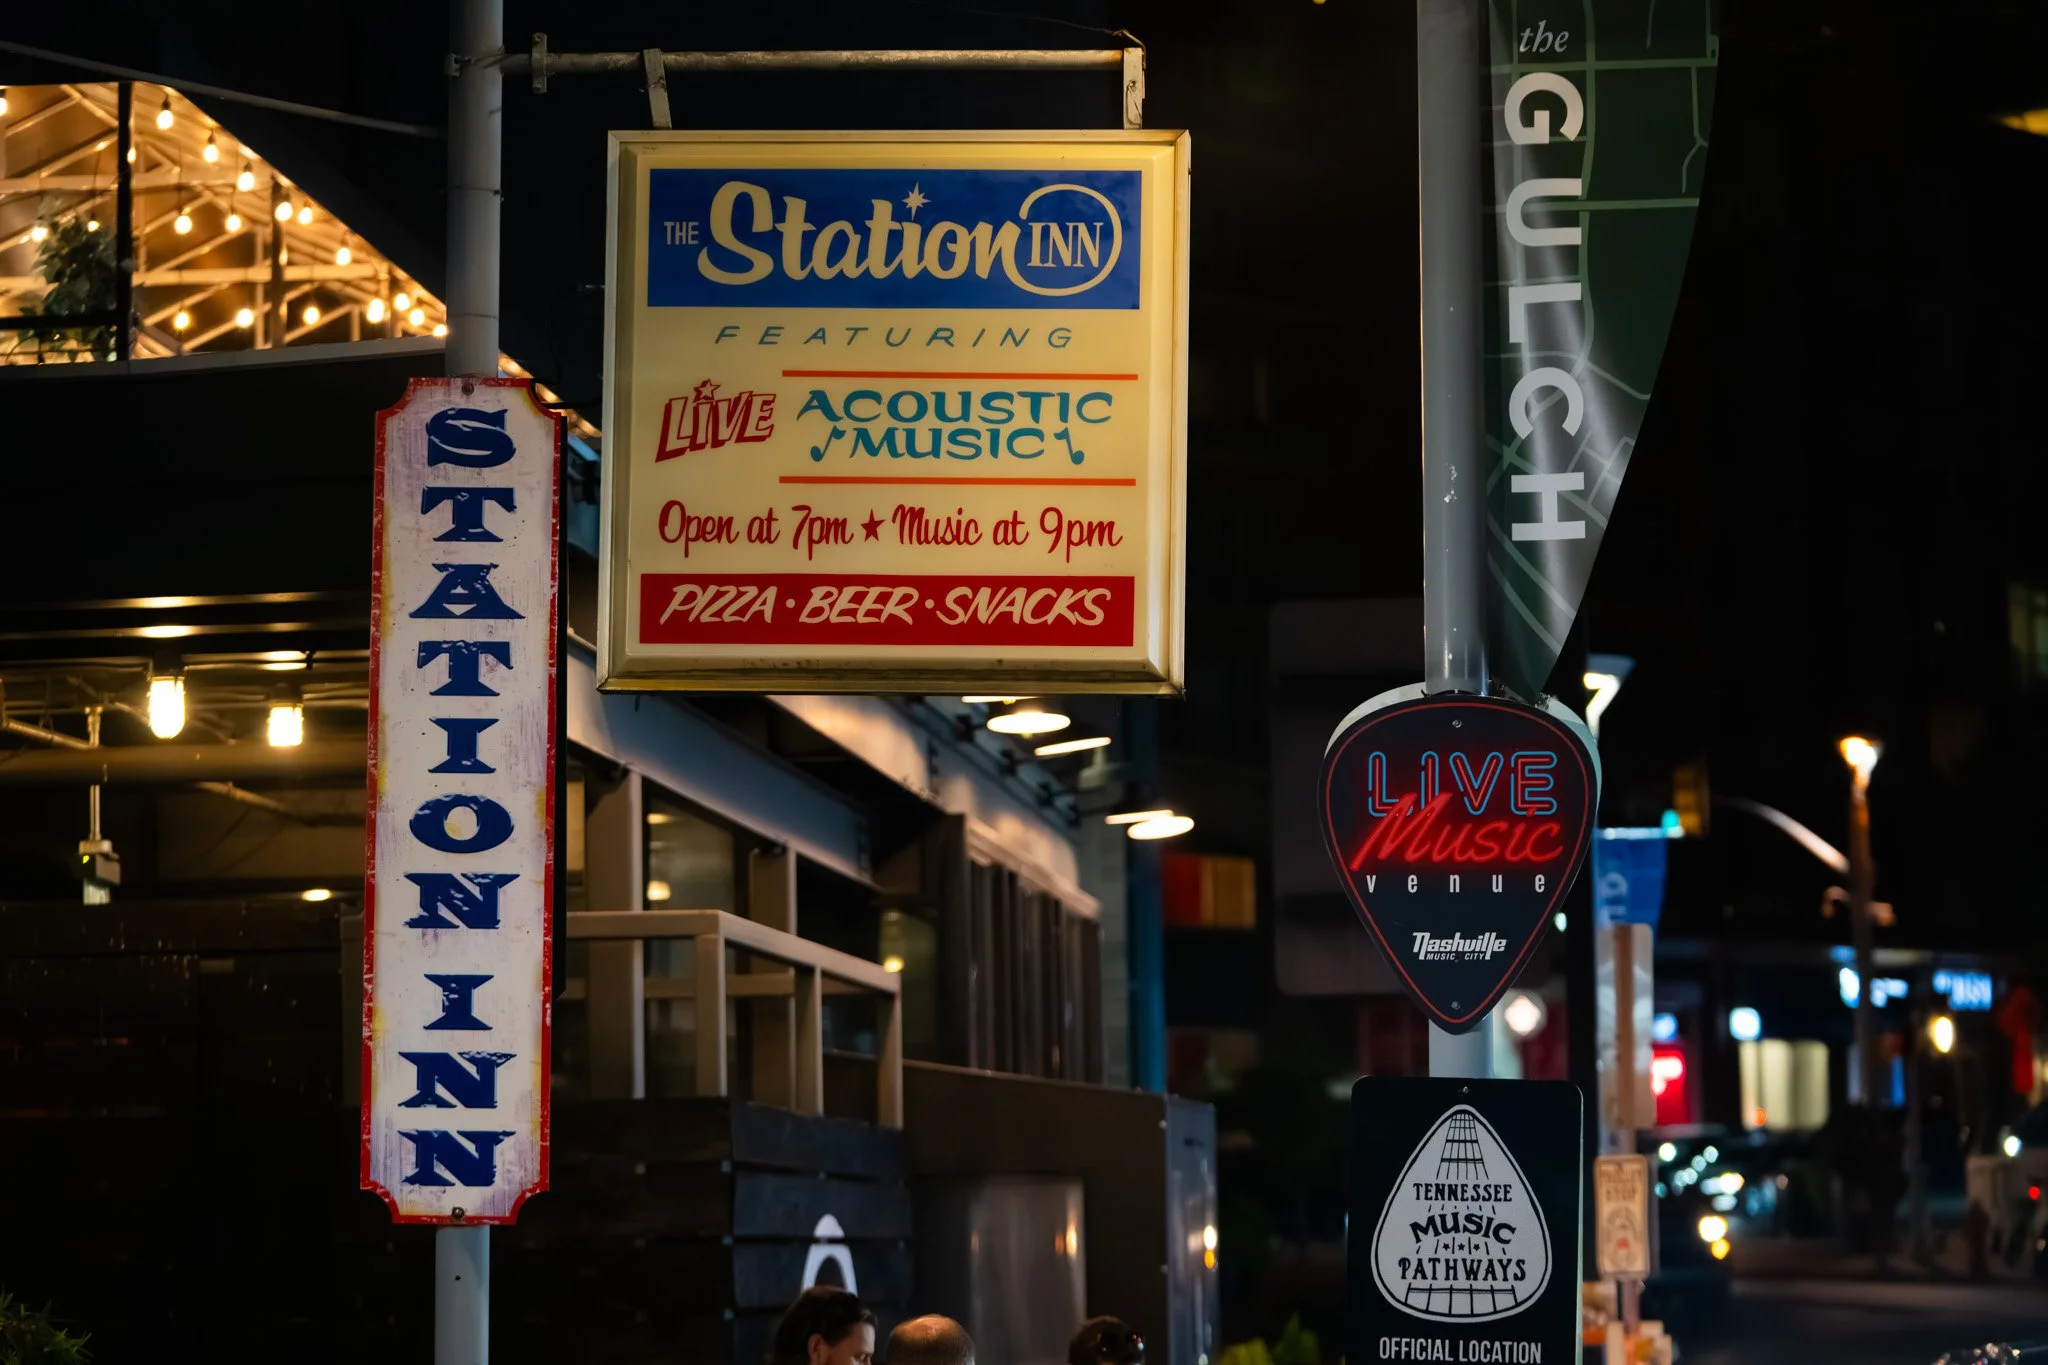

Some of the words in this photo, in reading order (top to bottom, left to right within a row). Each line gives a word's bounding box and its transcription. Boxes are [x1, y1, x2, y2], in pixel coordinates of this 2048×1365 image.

[1518, 20, 1569, 53] the
[663, 221, 699, 246] THE
[697, 180, 1028, 286] Station
[1027, 221, 1104, 269] INN
[1504, 72, 1586, 542] GULCH
[714, 325, 1073, 349] FEATURING
[797, 390, 1114, 425] ACOUSTIC
[849, 427, 1046, 461] MUSIC
[658, 500, 740, 559] Open
[747, 507, 780, 546] at
[791, 504, 855, 561] 7pm
[892, 503, 983, 547] Music
[992, 509, 1029, 548] at
[1039, 507, 1124, 563] 9pm
[659, 583, 780, 626] PIZZA
[798, 584, 921, 625] BEER
[935, 586, 1112, 627] SNACKS
[403, 407, 526, 929] STATION
[1368, 751, 1558, 816] LIVE
[1350, 791, 1564, 872] Music
[1366, 874, 1546, 893] venue
[1412, 932, 1507, 960] Nashville
[1426, 952, 1456, 960] MUSIC
[1464, 952, 1485, 960] CITY
[397, 973, 518, 1187] INN
[1413, 1183, 1513, 1202] TENNESSEE
[1409, 1212, 1517, 1245] MUSIC
[1398, 1257, 1526, 1282] PATHWAYS
[1379, 1336, 1454, 1362] OFFICIAL
[1459, 1339, 1542, 1364] LOCATION
